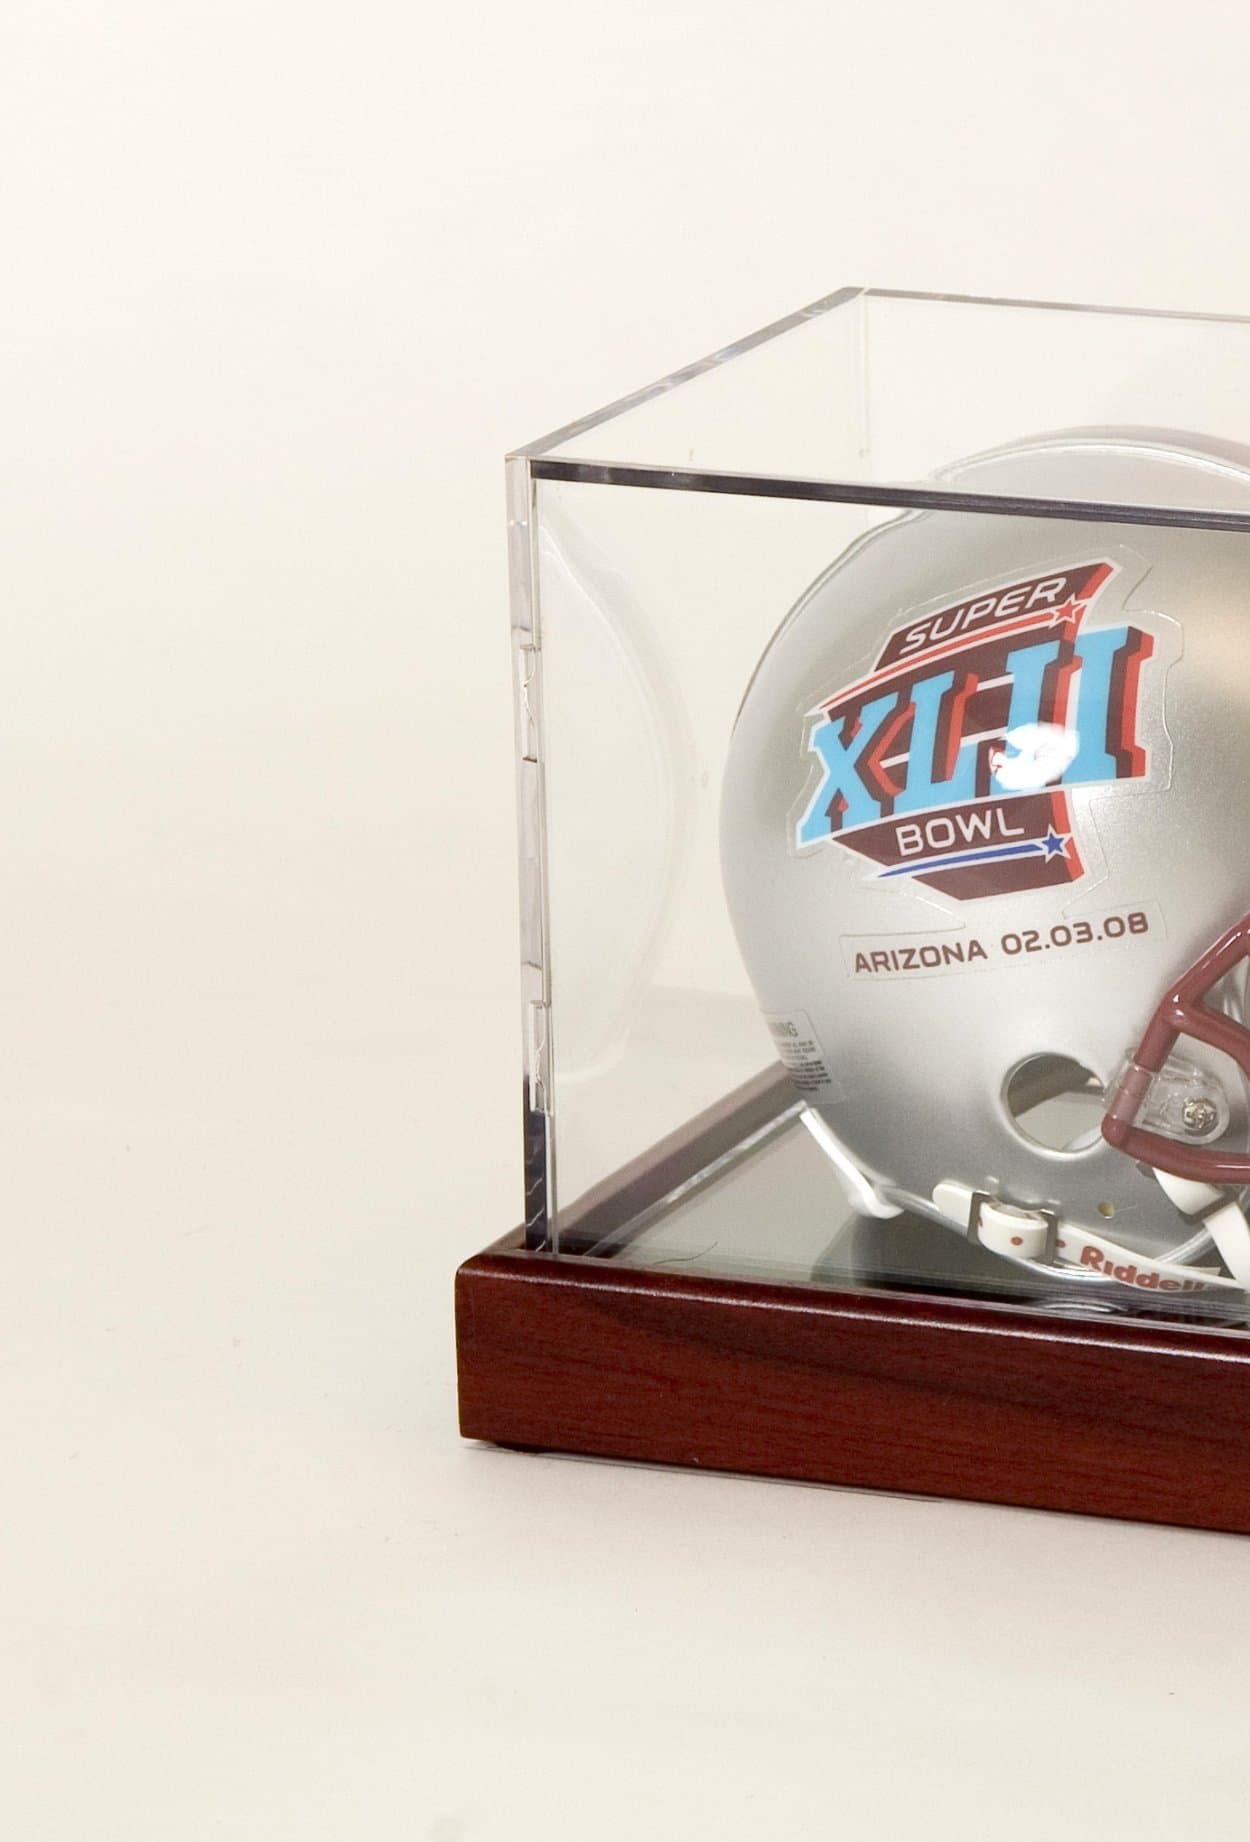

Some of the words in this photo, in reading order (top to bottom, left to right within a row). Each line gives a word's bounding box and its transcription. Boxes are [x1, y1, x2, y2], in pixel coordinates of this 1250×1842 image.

[899, 576, 1068, 656] SUPER
[796, 625, 1148, 848] XLII
[895, 806, 1025, 857] BOWL
[854, 940, 989, 973] ARIZONA
[1000, 911, 1149, 956] 02.03.08
